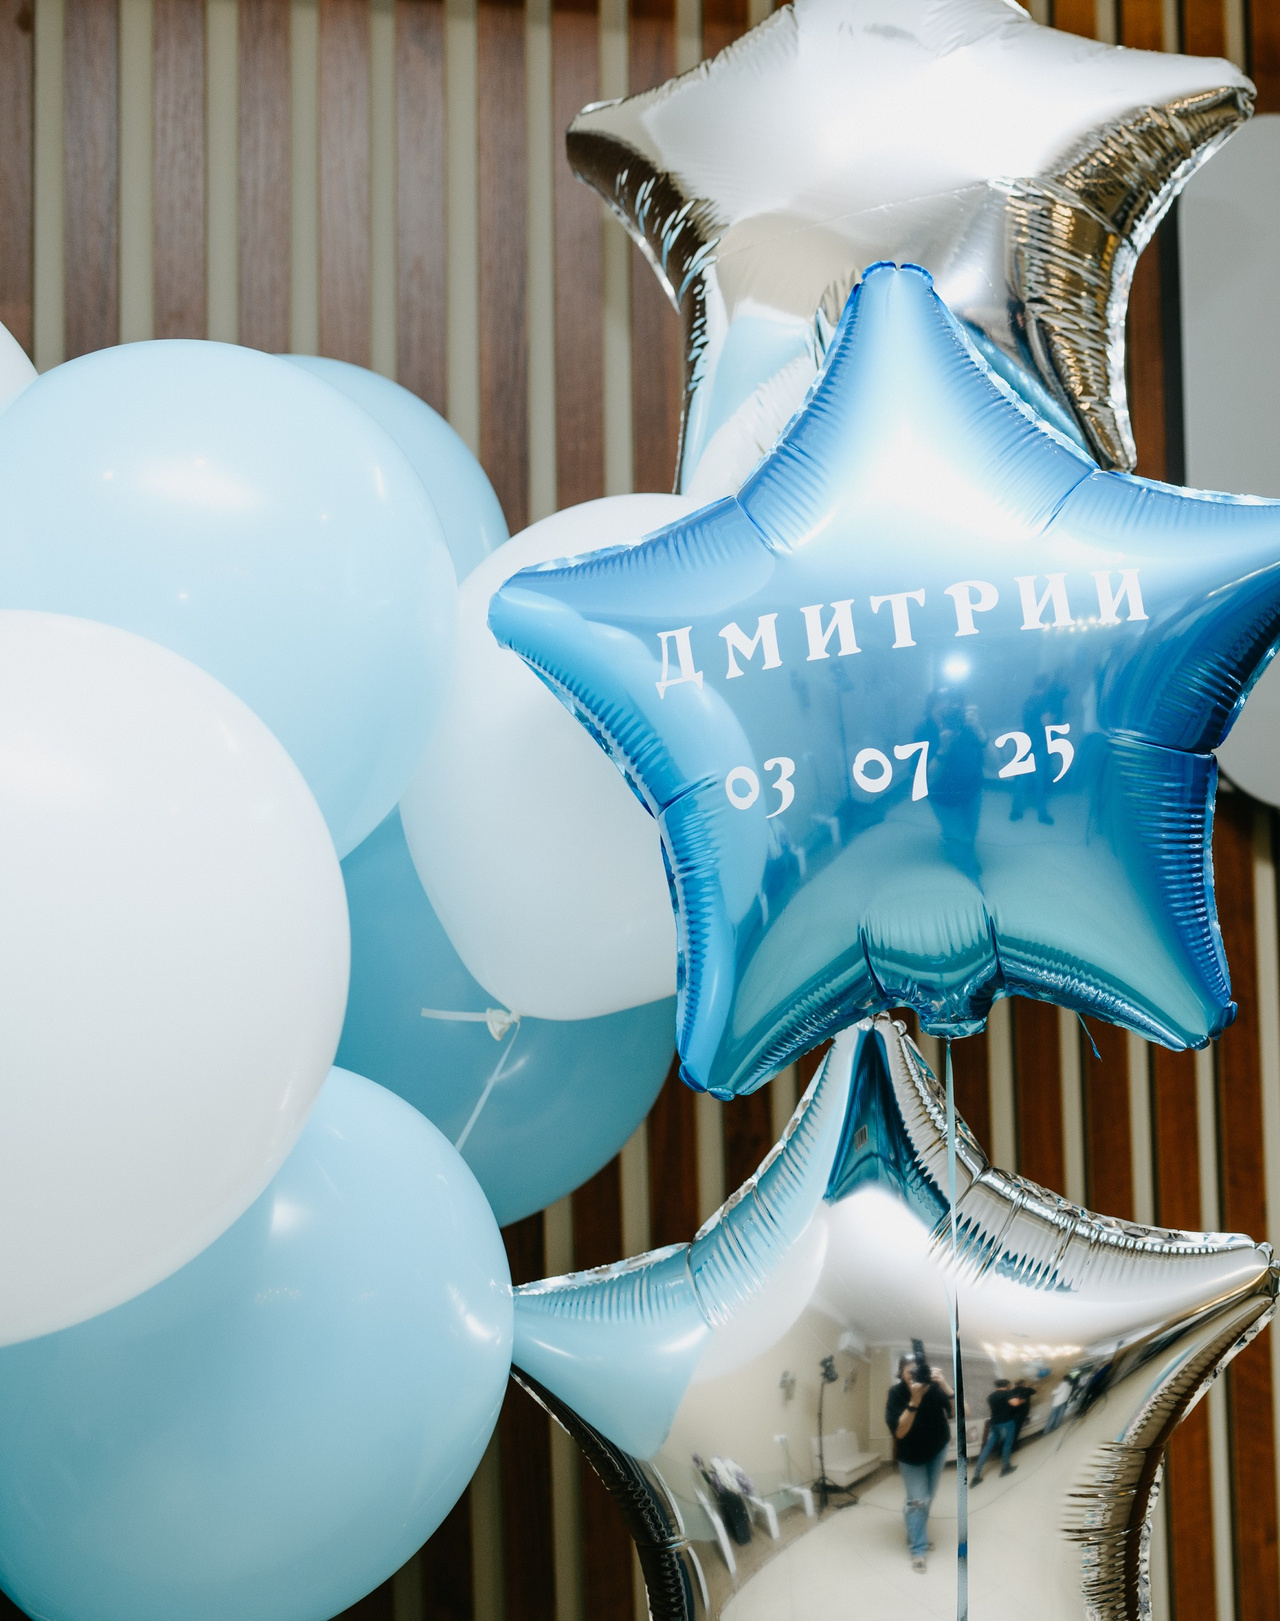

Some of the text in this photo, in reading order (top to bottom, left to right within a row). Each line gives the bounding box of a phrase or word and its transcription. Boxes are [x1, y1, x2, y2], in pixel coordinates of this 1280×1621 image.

[724, 722, 1075, 819] 03 07 25
